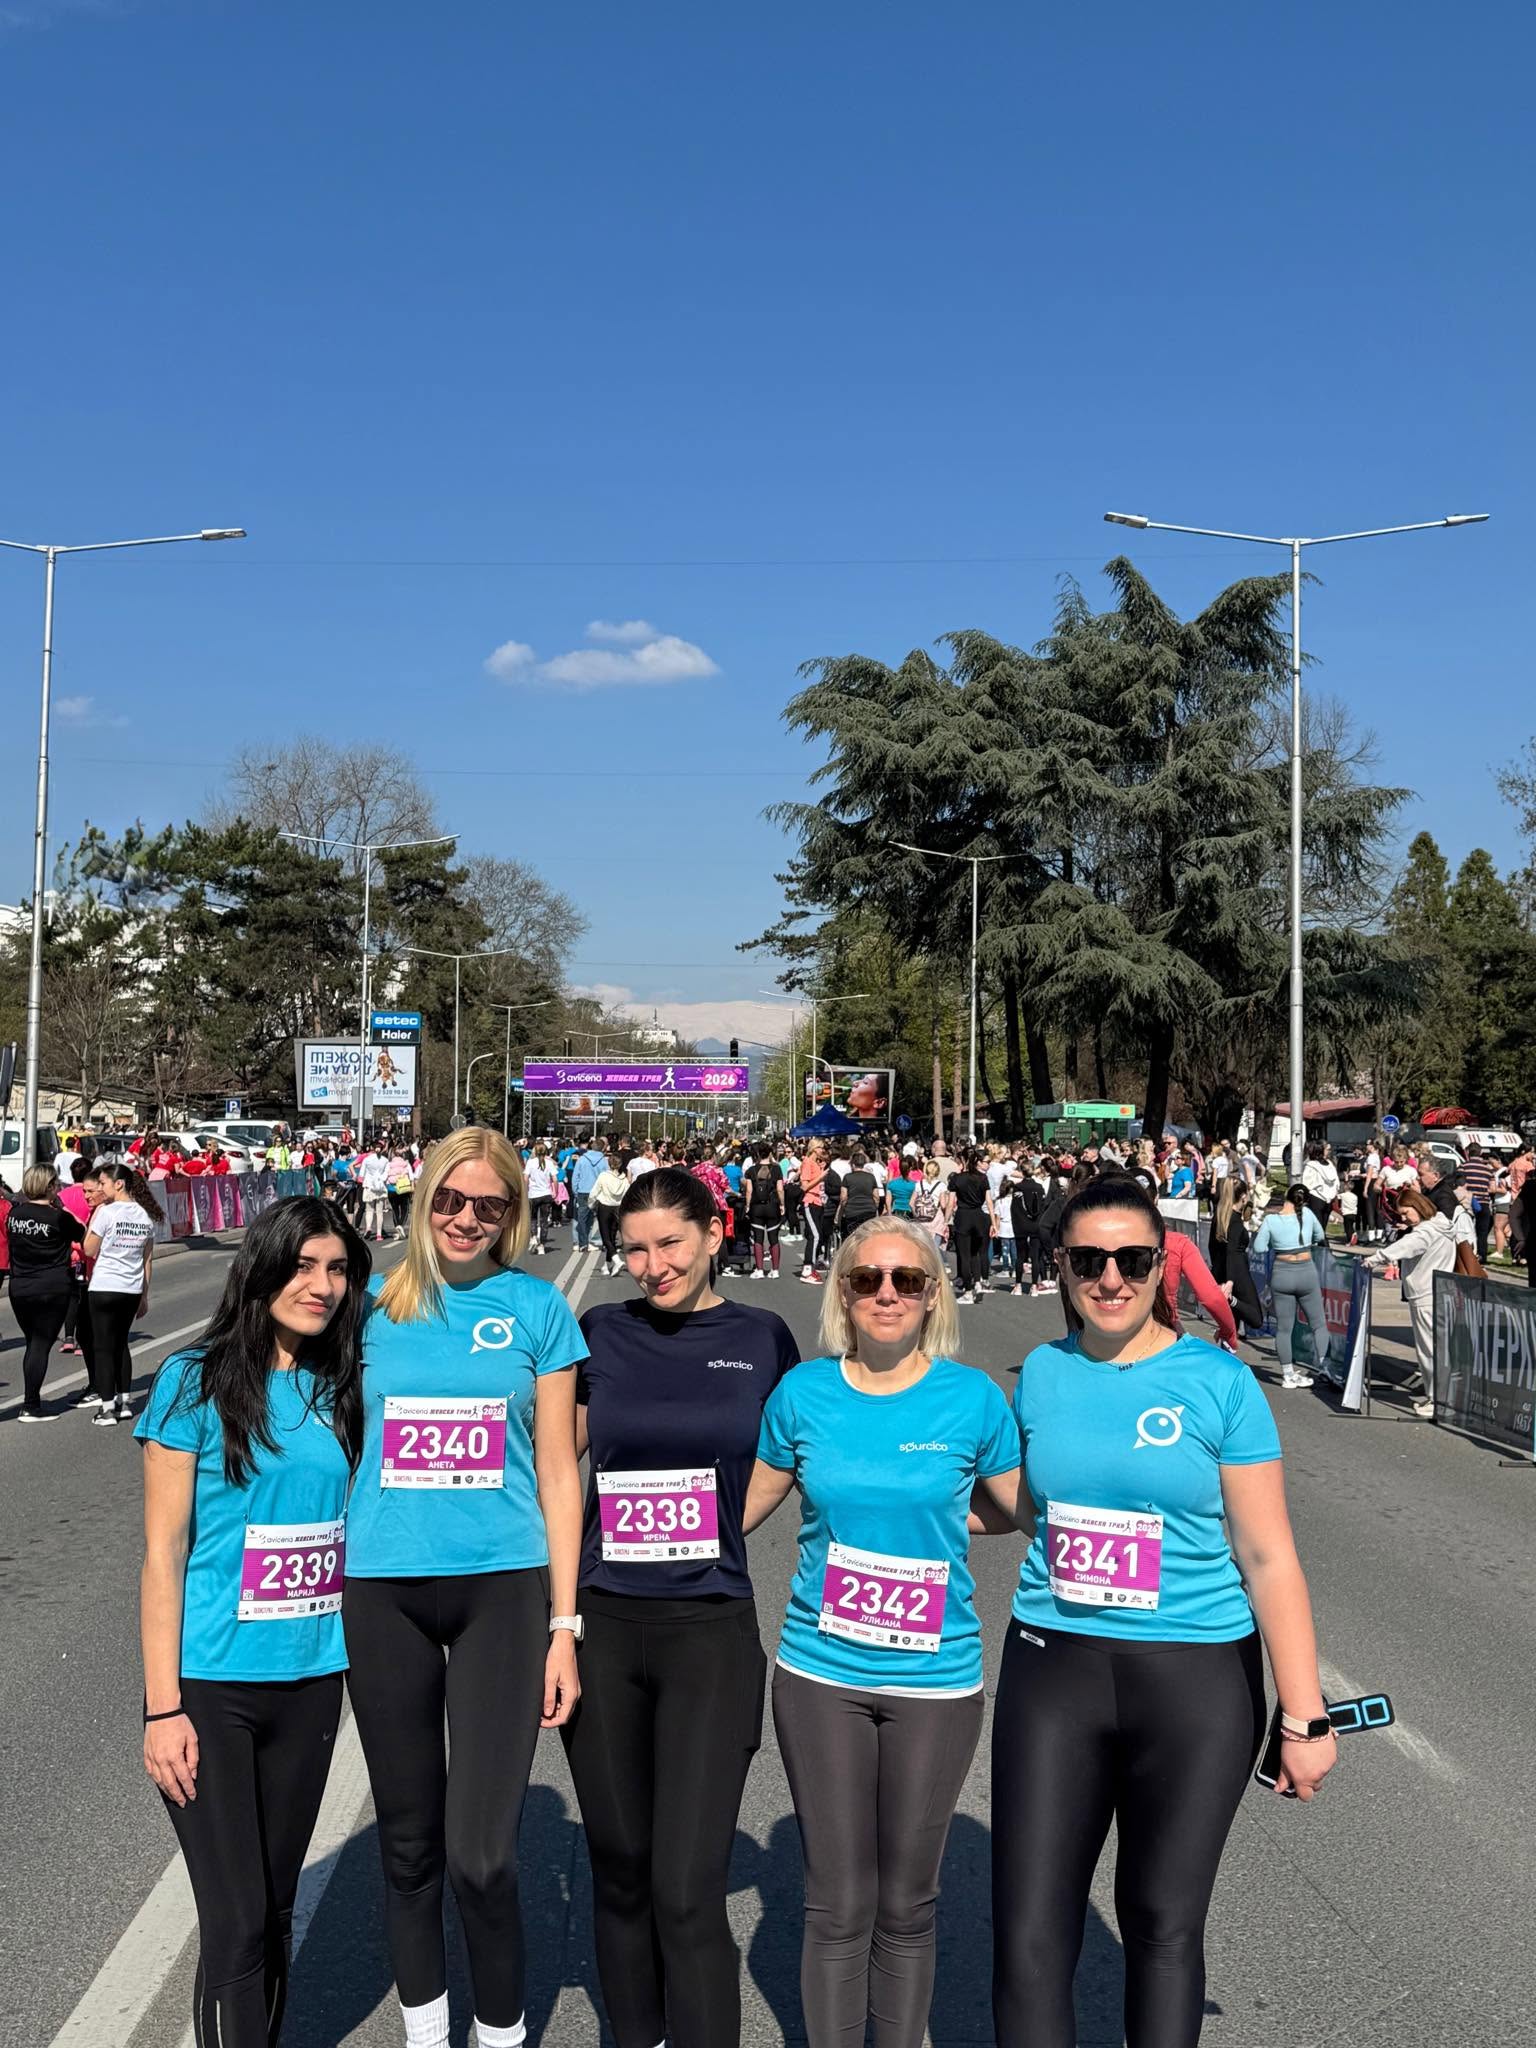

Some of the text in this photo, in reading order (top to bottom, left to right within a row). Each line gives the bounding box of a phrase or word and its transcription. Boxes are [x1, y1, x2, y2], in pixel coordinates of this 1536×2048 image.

[375, 1016, 418, 1025] setec
[381, 1030, 412, 1039] Haier
[310, 1065, 329, 1075] МЕ
[567, 1072, 602, 1082] avicena
[704, 1073, 736, 1086] 2026
[398, 1425, 489, 1460] 2340
[428, 1461, 455, 1469] АНЕТА
[615, 1497, 702, 1533] 2338
[643, 1533, 671, 1541] ИРЕНА
[1055, 1532, 1139, 1578] 2341
[259, 1549, 337, 1590] 2339
[1074, 1573, 1111, 1585] СИМОНА
[287, 1588, 316, 1598] МАРИЈА
[838, 1575, 930, 1622] 2342
[859, 1614, 902, 1629] ЈУЛИЈАНА
